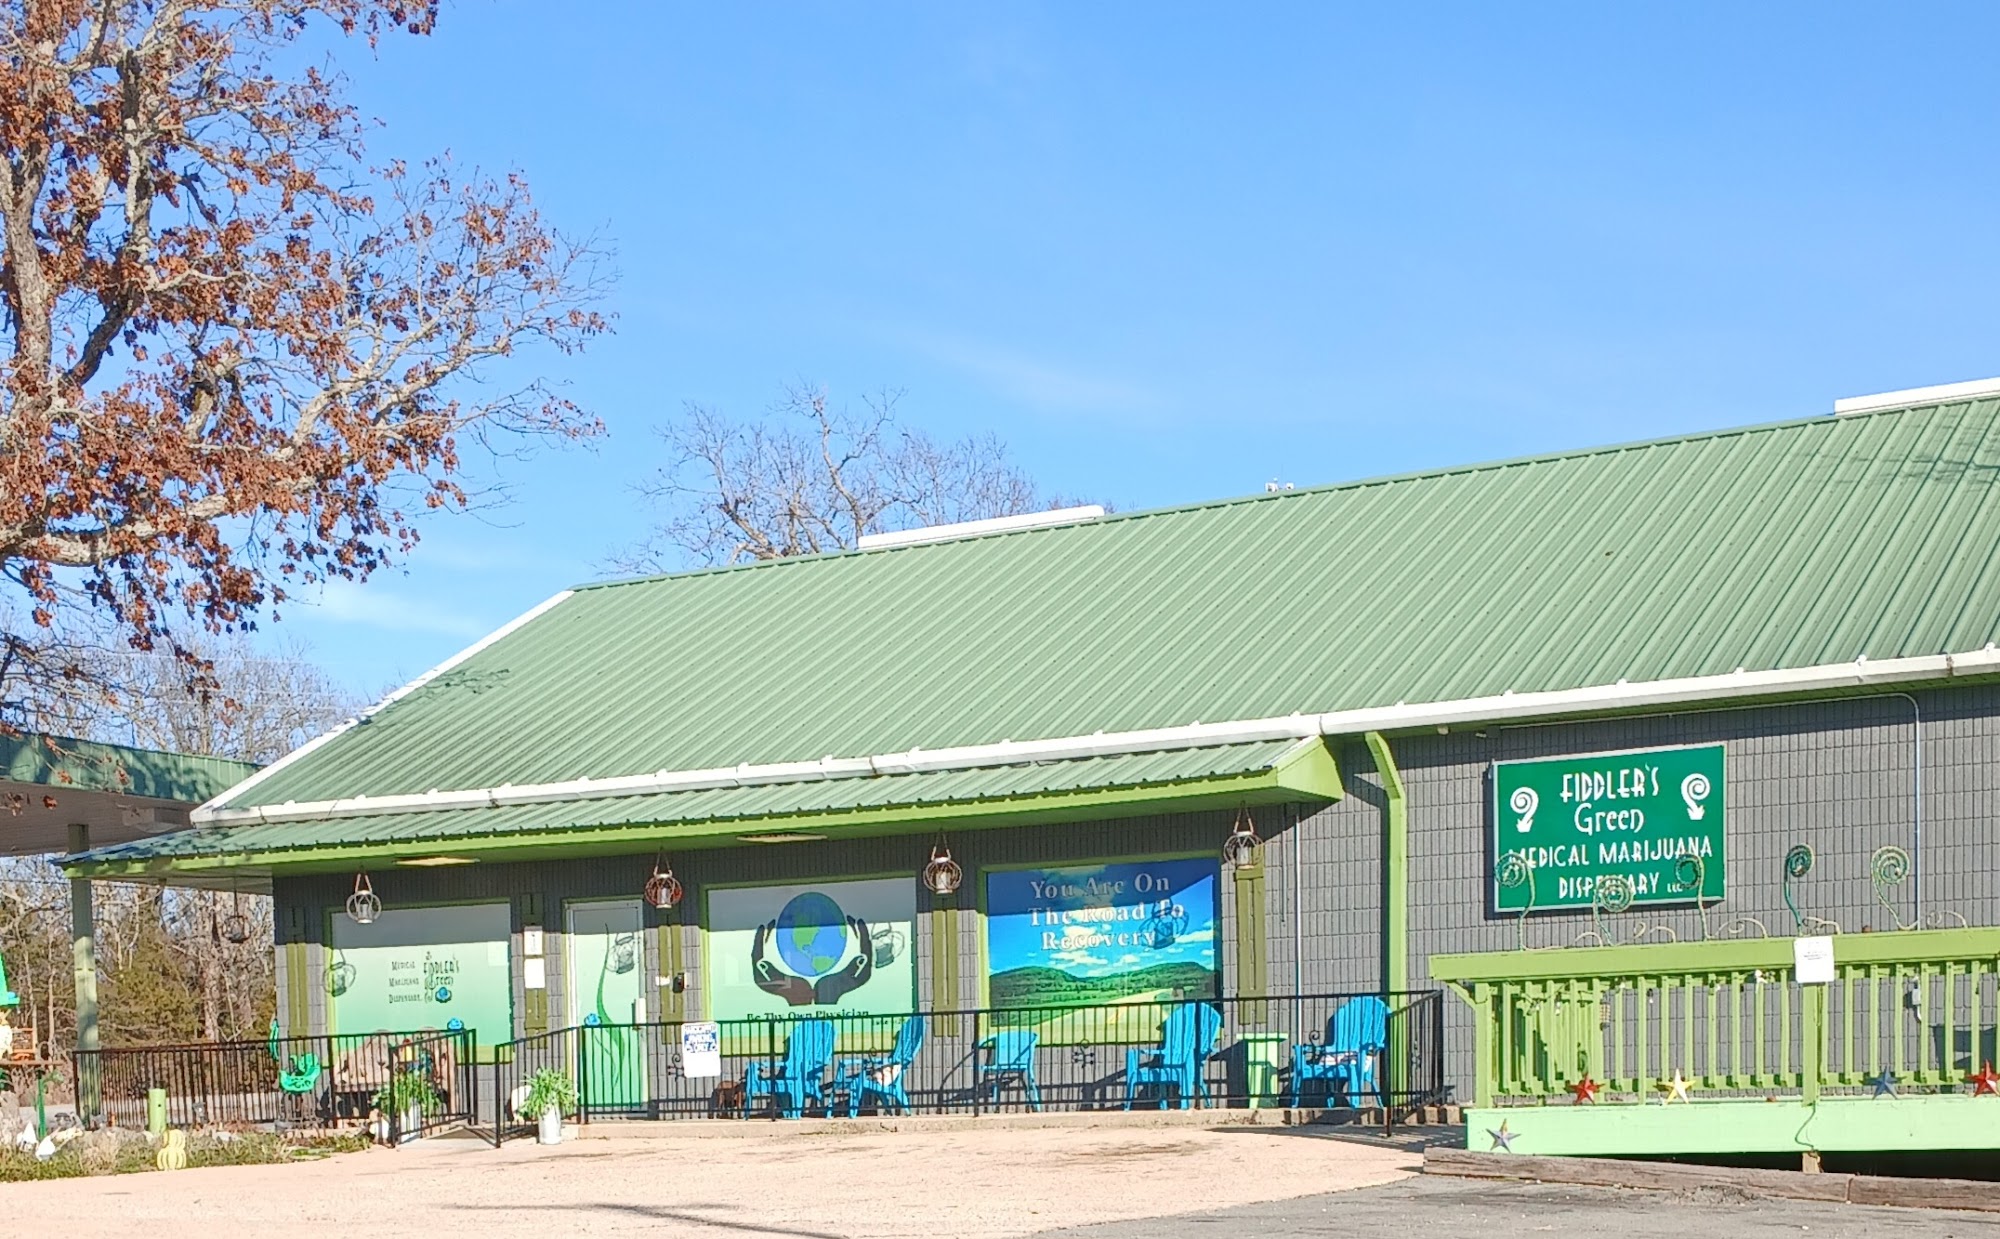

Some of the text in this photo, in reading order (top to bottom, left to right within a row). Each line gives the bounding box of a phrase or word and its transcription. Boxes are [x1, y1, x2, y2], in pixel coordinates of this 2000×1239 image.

[1560, 763, 1659, 803] FIDDLER'S
[1574, 803, 1645, 835] Green
[1600, 835, 1712, 865] MARIJUANA
[1030, 873, 1170, 899] You Are On
[1028, 899, 1184, 926] The Road To
[1041, 928, 1156, 950] Recovery
